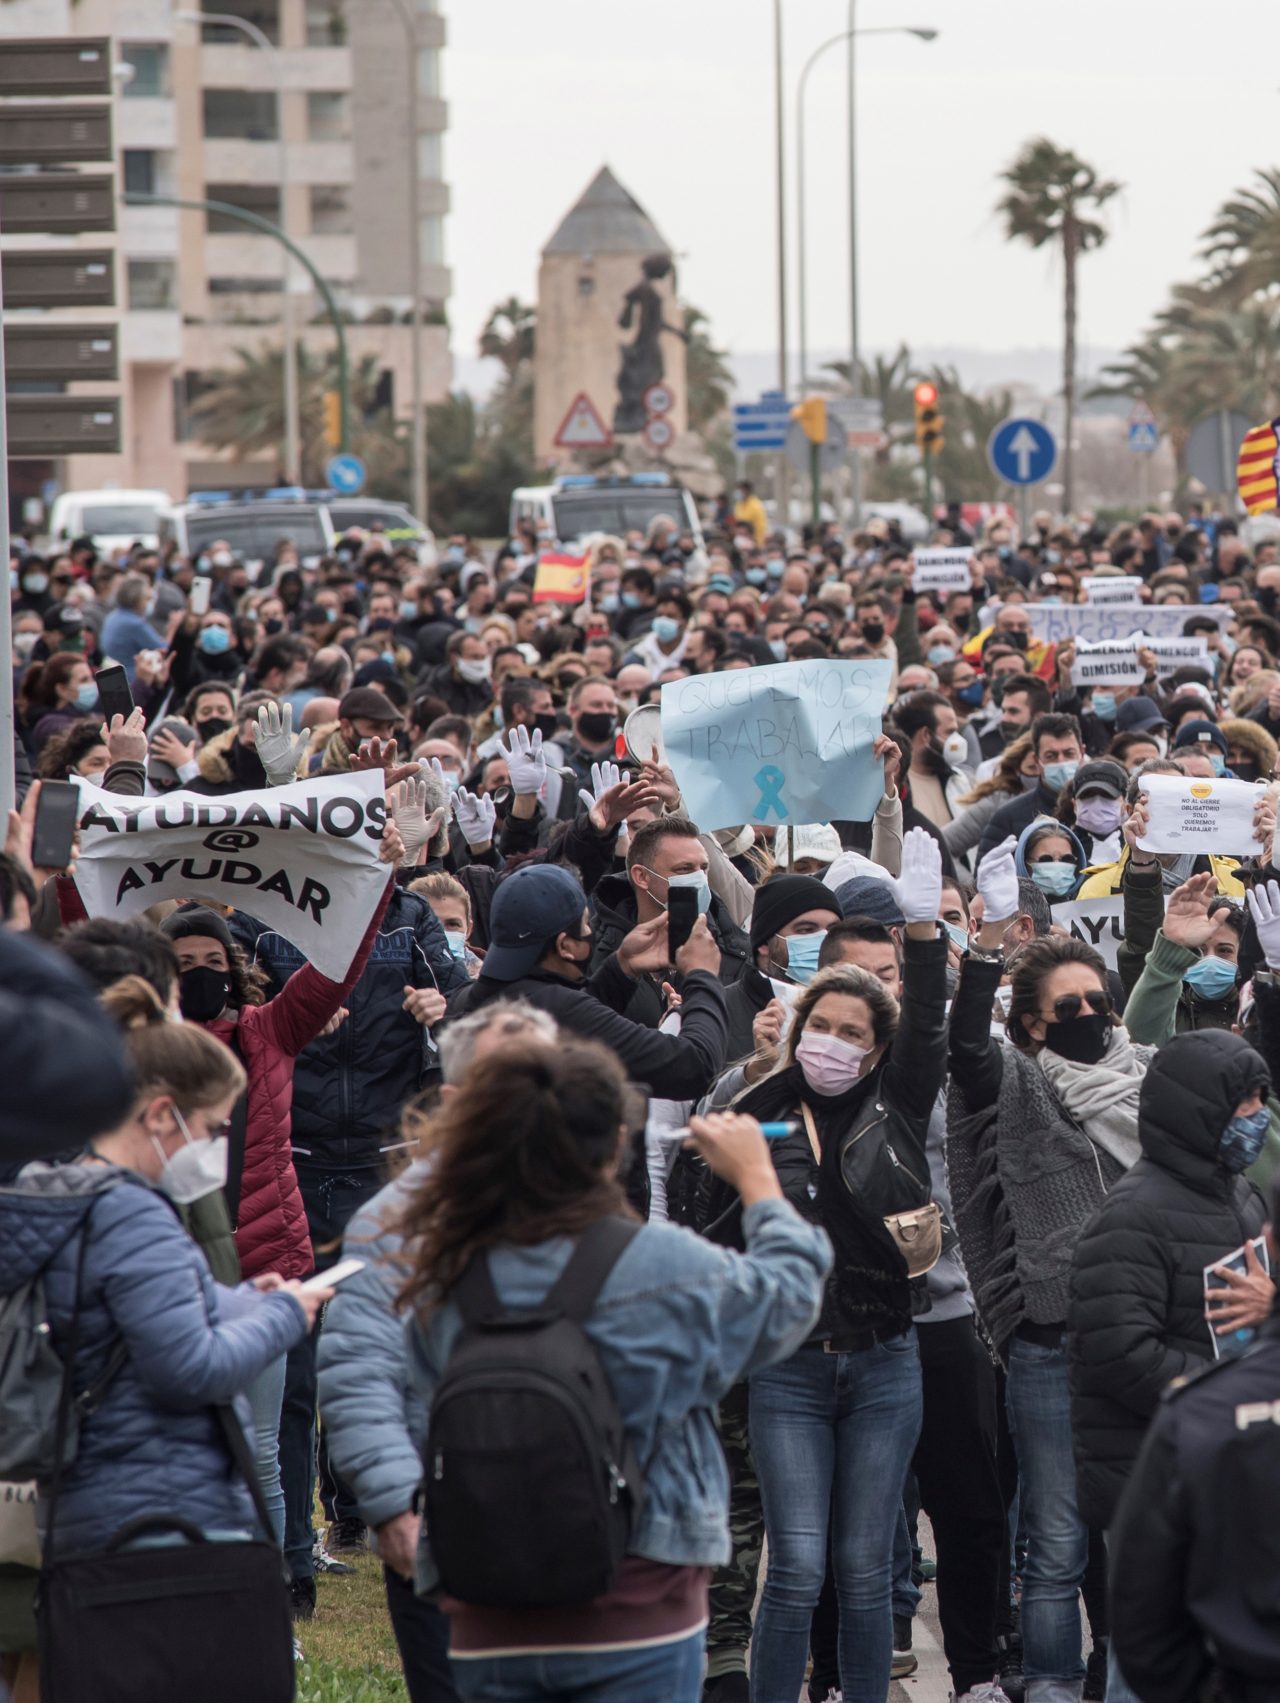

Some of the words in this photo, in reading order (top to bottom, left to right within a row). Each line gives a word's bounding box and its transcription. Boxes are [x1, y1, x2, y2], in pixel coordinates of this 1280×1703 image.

[1081, 660, 1138, 678] DIMISIÓN
[678, 668, 873, 714] QUEREMOS
[79, 797, 386, 840] AYUDANOS
[202, 829, 259, 853] @
[116, 858, 331, 926] AYUDAR
